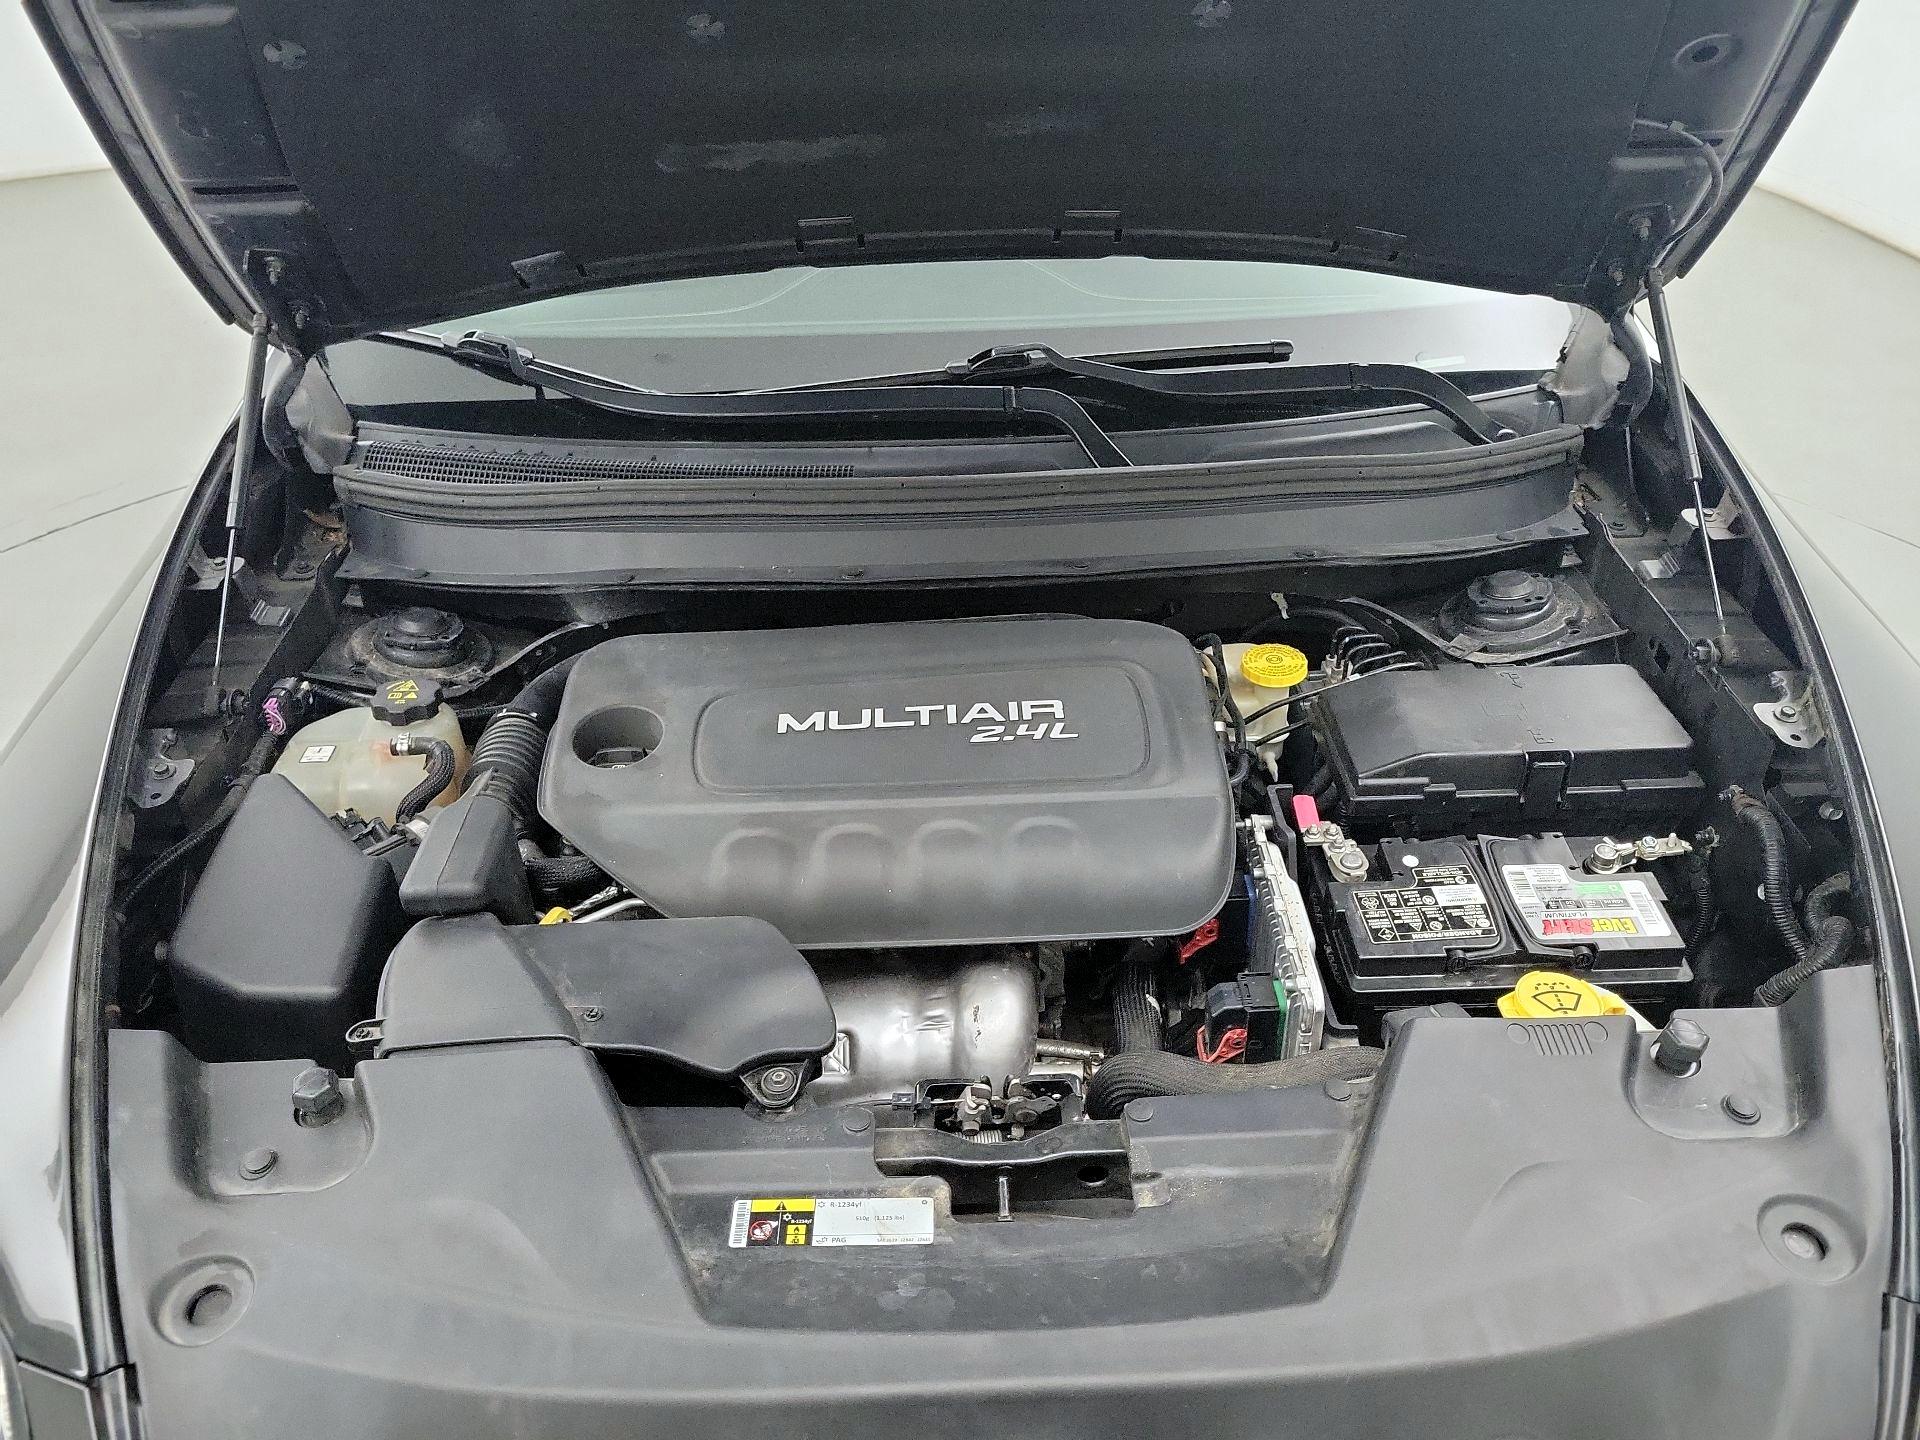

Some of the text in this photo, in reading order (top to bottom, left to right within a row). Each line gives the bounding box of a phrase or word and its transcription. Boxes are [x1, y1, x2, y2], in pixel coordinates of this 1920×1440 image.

[776, 699, 1066, 734] MULTIAIR
[969, 722, 1079, 744] 2.4L
[1544, 911, 1588, 919] PLATINUM
[1542, 917, 1638, 936] EverStart
[830, 1201, 862, 1209] R-1234yf
